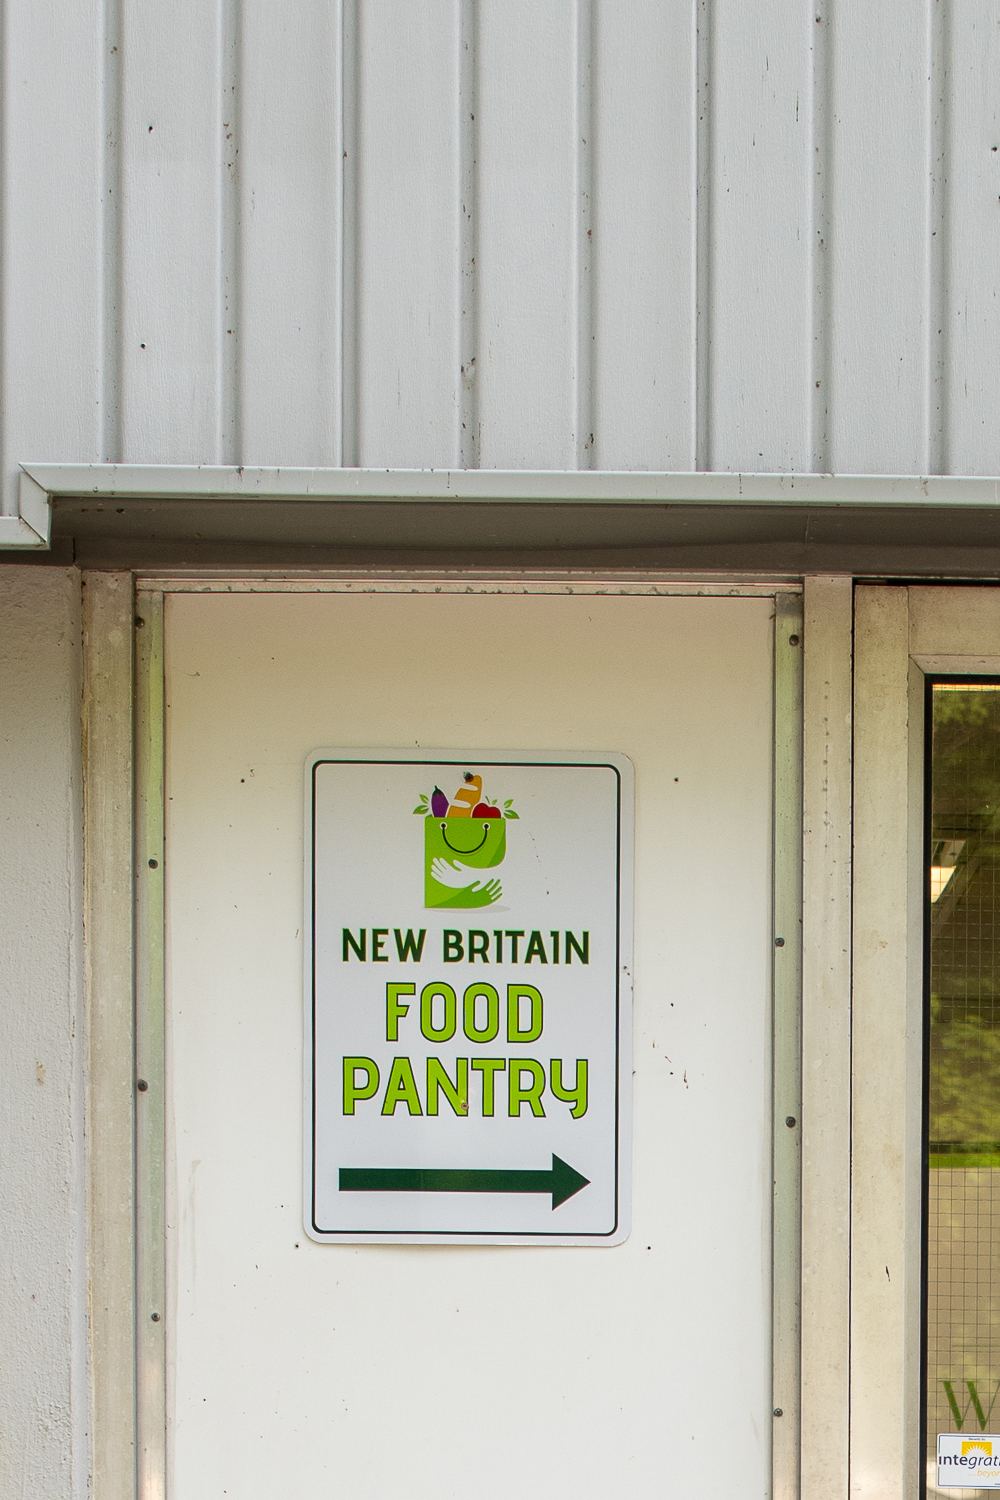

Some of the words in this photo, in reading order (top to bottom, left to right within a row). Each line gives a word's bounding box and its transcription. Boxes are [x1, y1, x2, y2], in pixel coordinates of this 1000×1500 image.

[342, 928, 426, 963] NEW
[443, 929, 590, 965] BRITAIN
[385, 981, 544, 1044] FOOD
[342, 1056, 589, 1120] PANTRY
